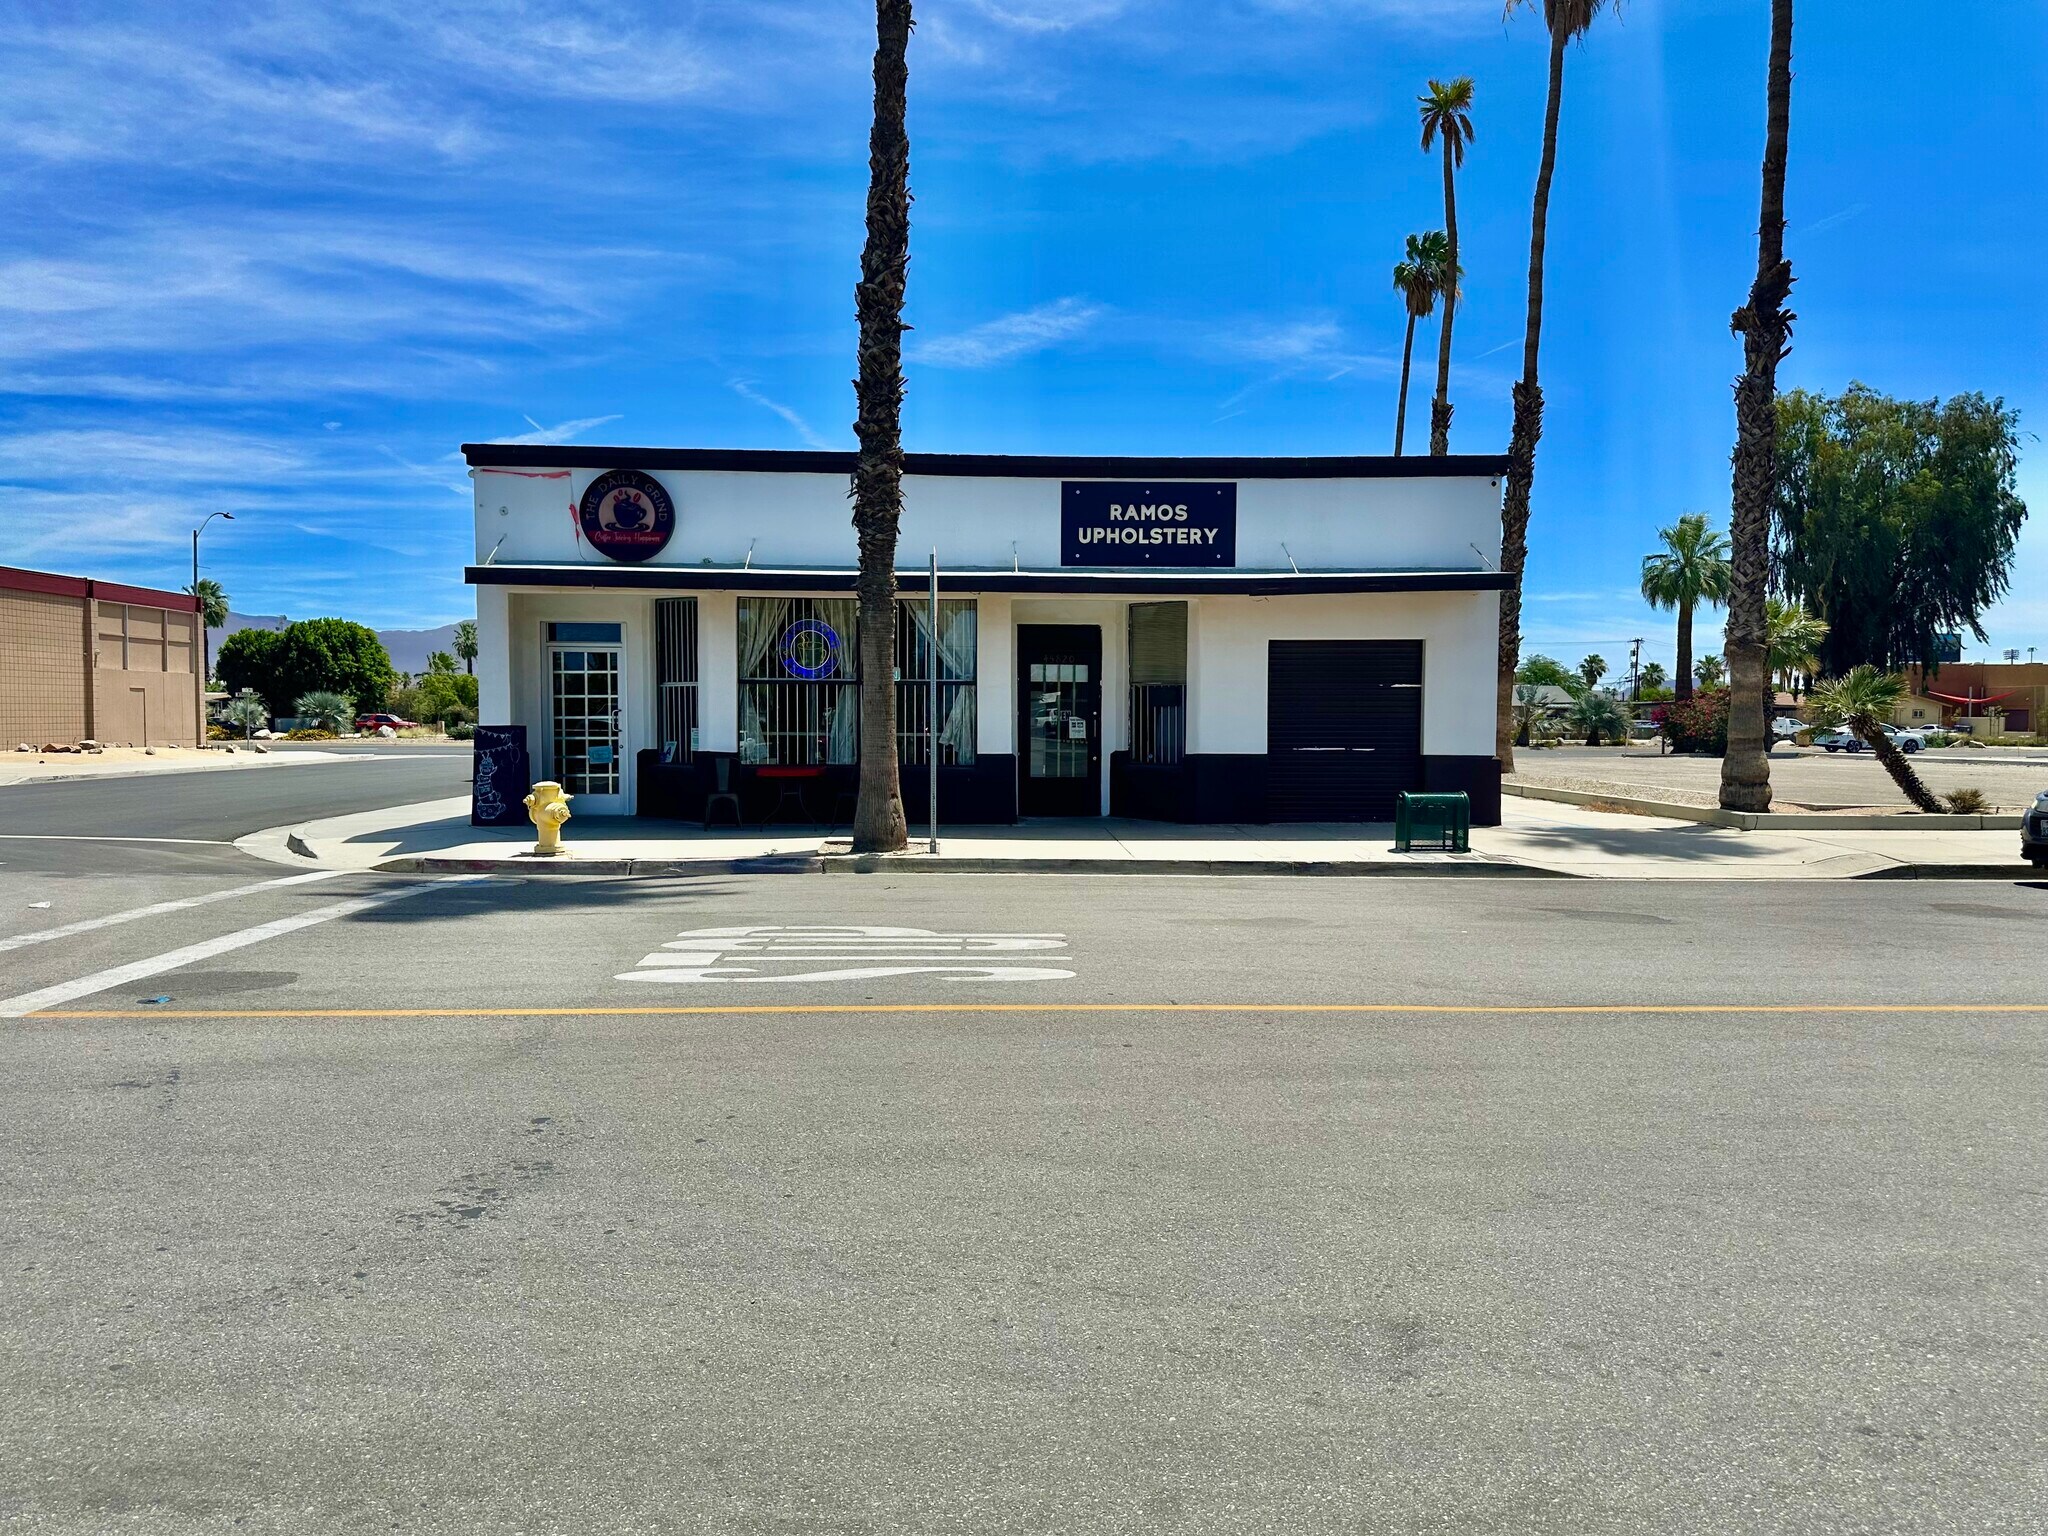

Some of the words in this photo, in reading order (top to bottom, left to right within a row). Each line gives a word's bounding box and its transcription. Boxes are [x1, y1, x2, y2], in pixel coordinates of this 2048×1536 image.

[586, 494, 599, 521] THE
[598, 475, 638, 492] DAILY
[644, 483, 668, 521] GRIND
[1110, 504, 1188, 521] RAMOS
[1078, 527, 1219, 545] UPHOLSTERY
[613, 925, 1078, 984] STOP
